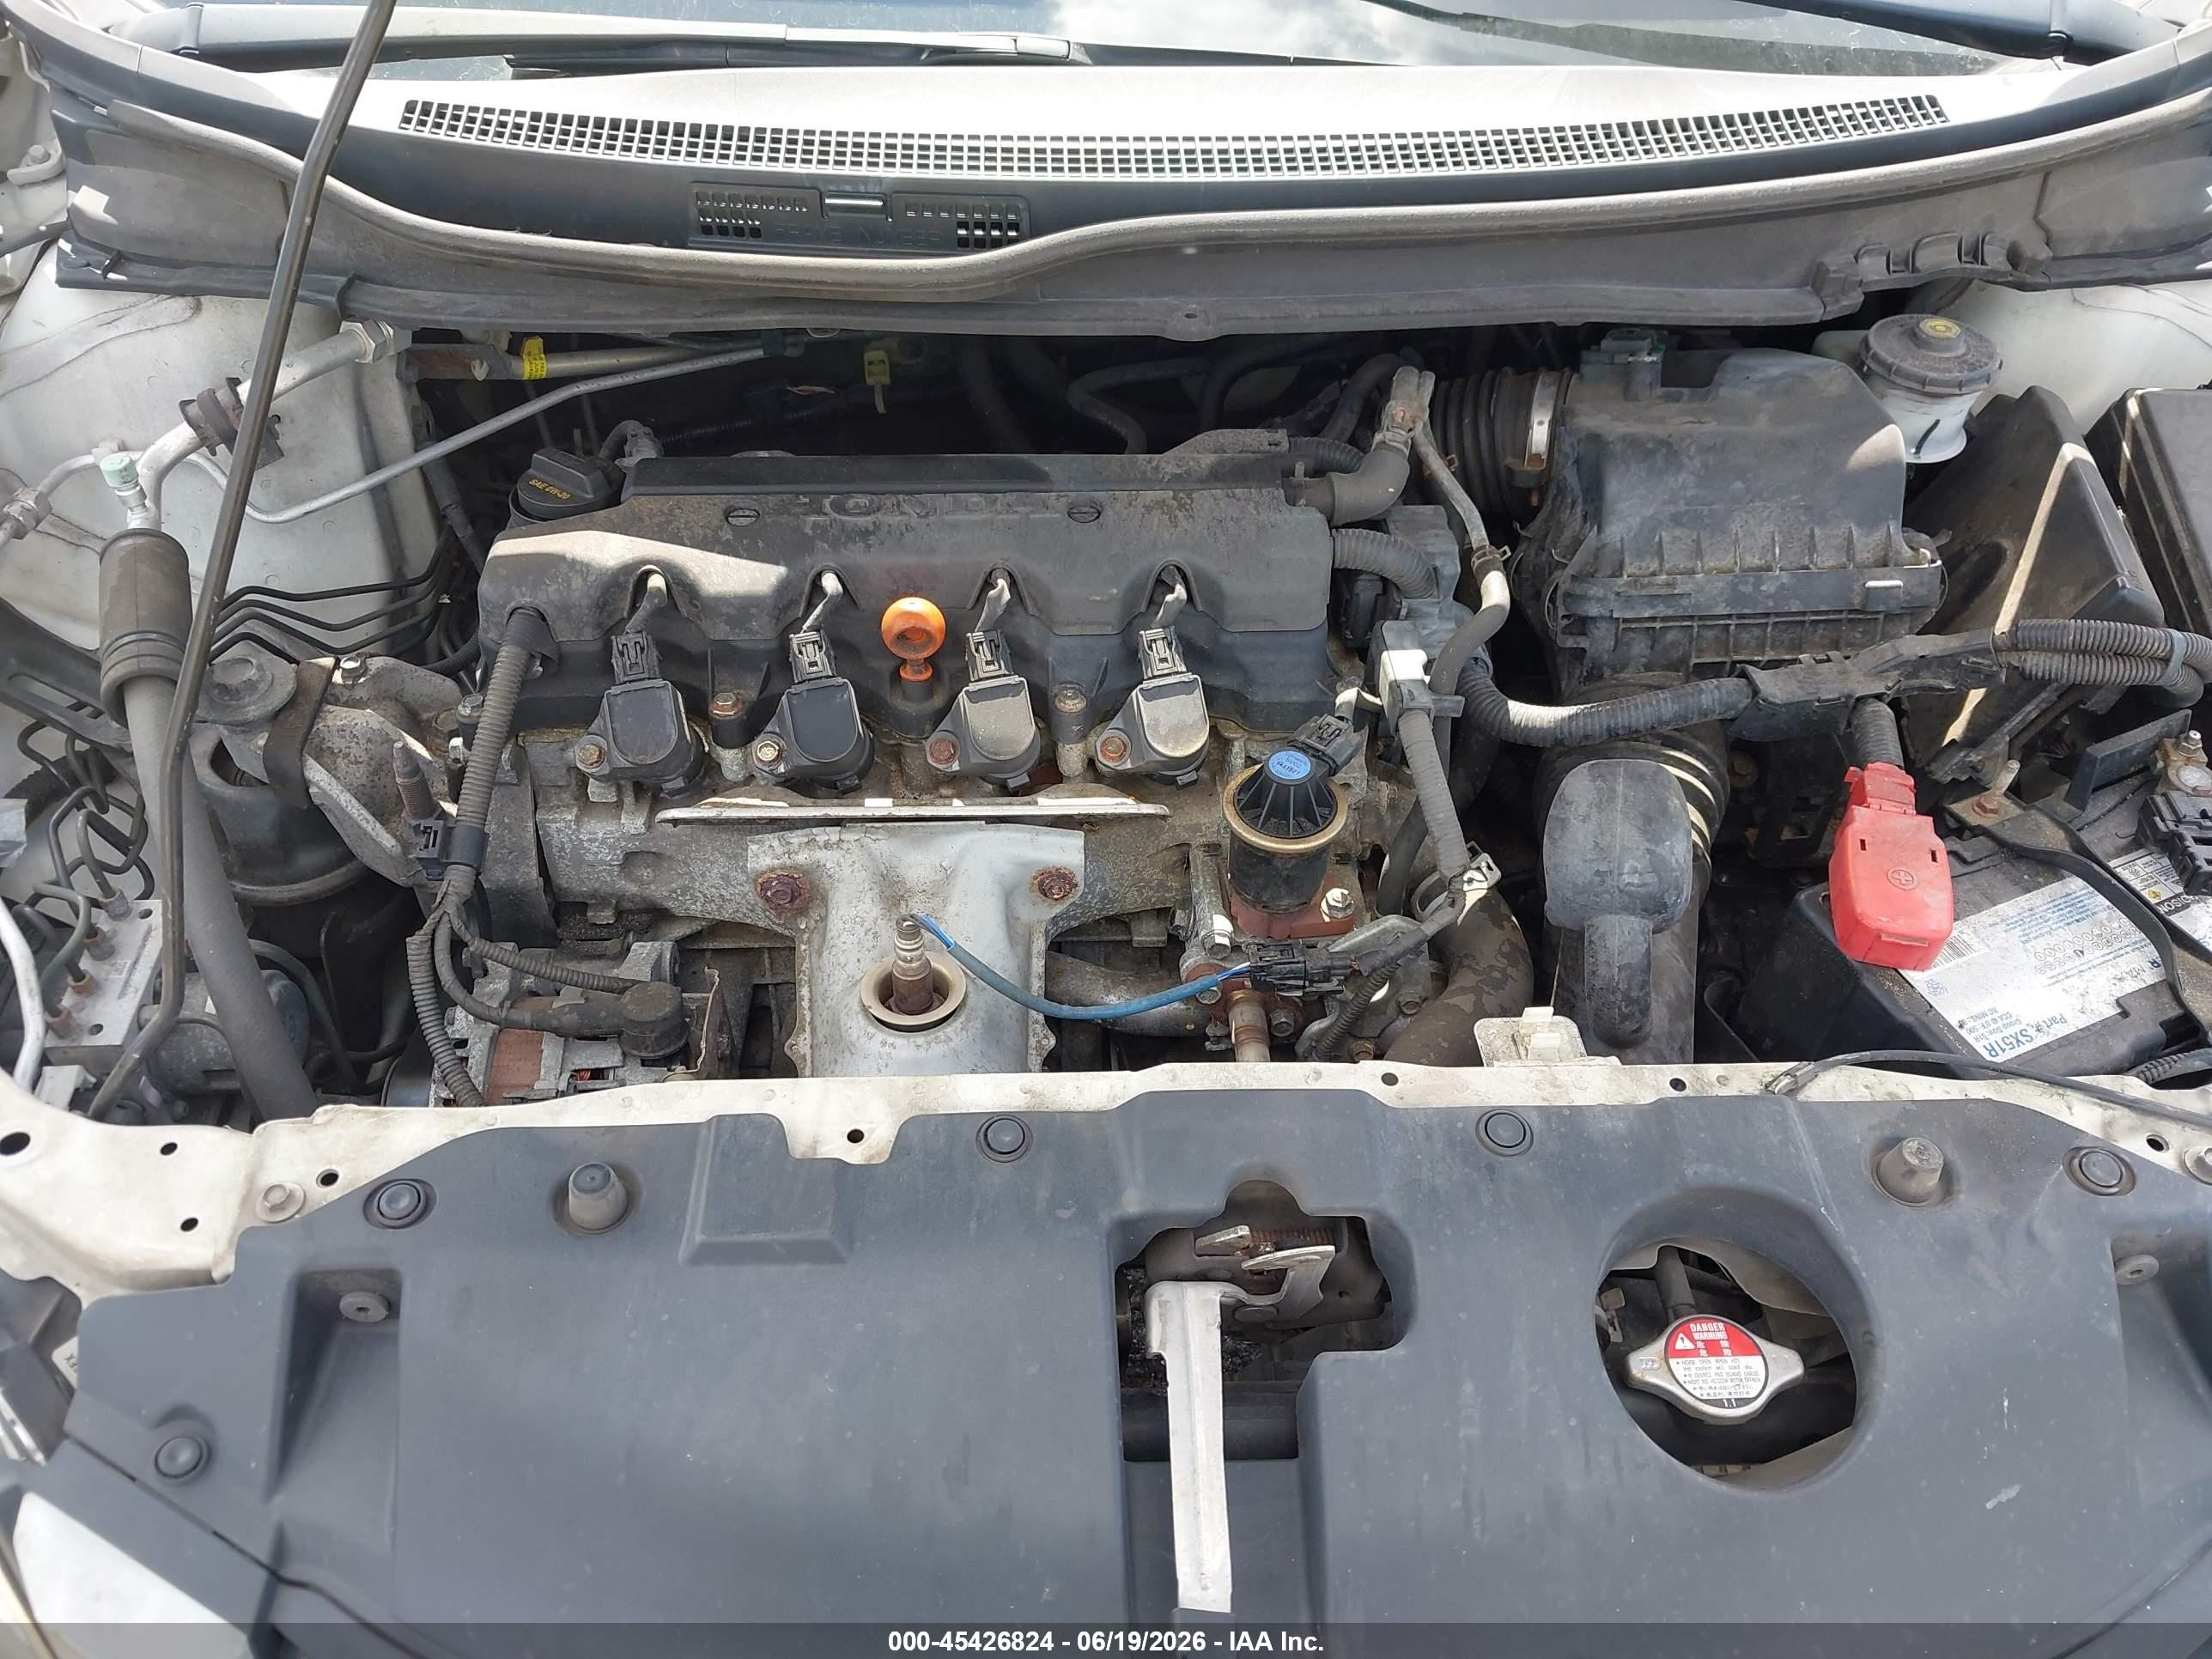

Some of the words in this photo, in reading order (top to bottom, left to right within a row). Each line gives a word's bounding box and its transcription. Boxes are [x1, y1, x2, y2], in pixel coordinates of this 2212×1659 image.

[528, 478, 547, 491] SAE
[2042, 1012, 2068, 1030] Part
[1983, 1028, 2034, 1058] SX51R
[1690, 1322, 1726, 1332] DANGER
[1723, 1399, 1738, 1408] 1.1
